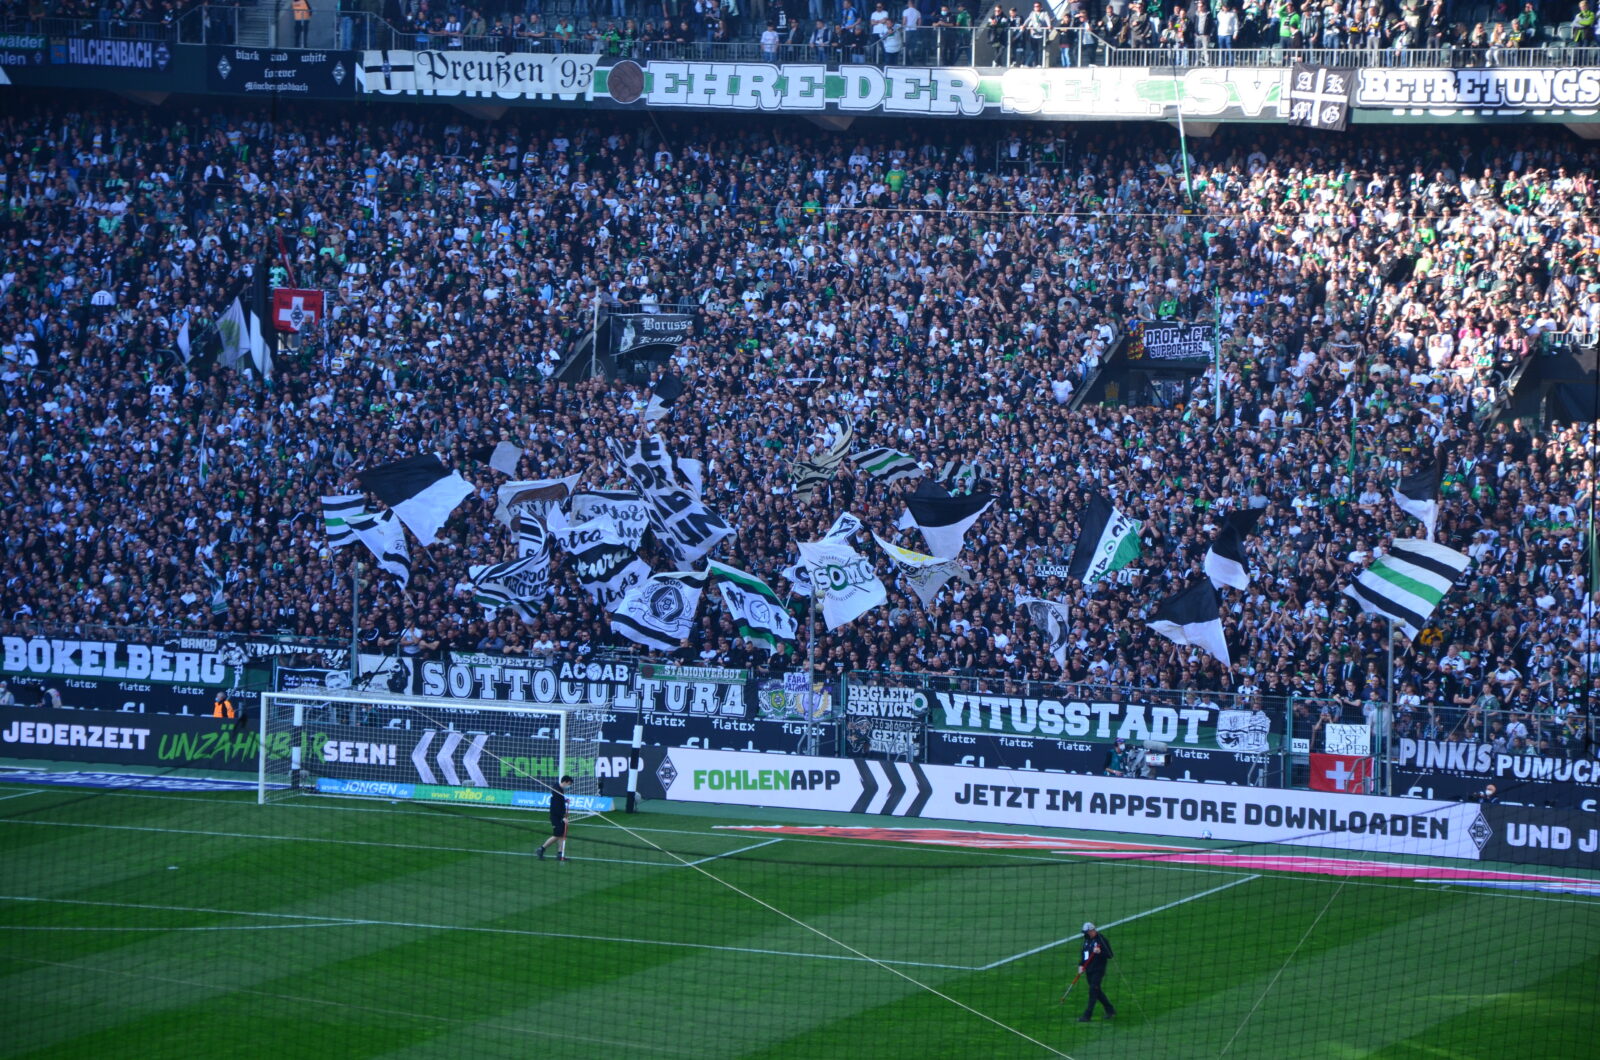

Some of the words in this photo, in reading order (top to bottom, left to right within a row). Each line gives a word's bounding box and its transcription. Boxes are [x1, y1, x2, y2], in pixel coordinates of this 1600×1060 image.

[69, 38, 152, 67] HILCHENBACH
[301, 53, 327, 65] white
[416, 50, 545, 88] Preußen
[648, 61, 826, 109] EHRE
[839, 64, 985, 116] DER
[1360, 68, 1600, 107] BETRETUNGS
[1150, 341, 1204, 359] SUPPORTERS
[664, 665, 741, 679] STADIONVERBOT
[65, 679, 97, 690] flatex
[119, 681, 151, 693] flatex
[172, 684, 205, 696] flatex
[422, 660, 746, 717] SOTTOCULTURA
[847, 685, 914, 702] BEGLEIT
[846, 700, 917, 719] SERVICE
[643, 714, 686, 727] flatex
[712, 719, 755, 732] flatex
[935, 693, 1209, 744] VITUSSTADT
[3, 721, 150, 750] JEDERZEIT
[323, 741, 397, 766] SEIN!
[942, 734, 976, 745] flatex
[999, 738, 1034, 748] flatex
[1057, 742, 1092, 752] flatex
[1174, 749, 1210, 760] flatex
[1328, 743, 1369, 755] SUPER
[1398, 738, 1493, 774] PINKIS
[341, 781, 398, 796] JONGEN
[693, 769, 842, 791] FOHLENAPP
[954, 783, 1040, 808] JETZT
[1046, 789, 1083, 813] IM
[1089, 792, 1237, 825] APPSTORE
[1244, 804, 1449, 841] DOWNLOADEN
[1506, 823, 1572, 850] UND
